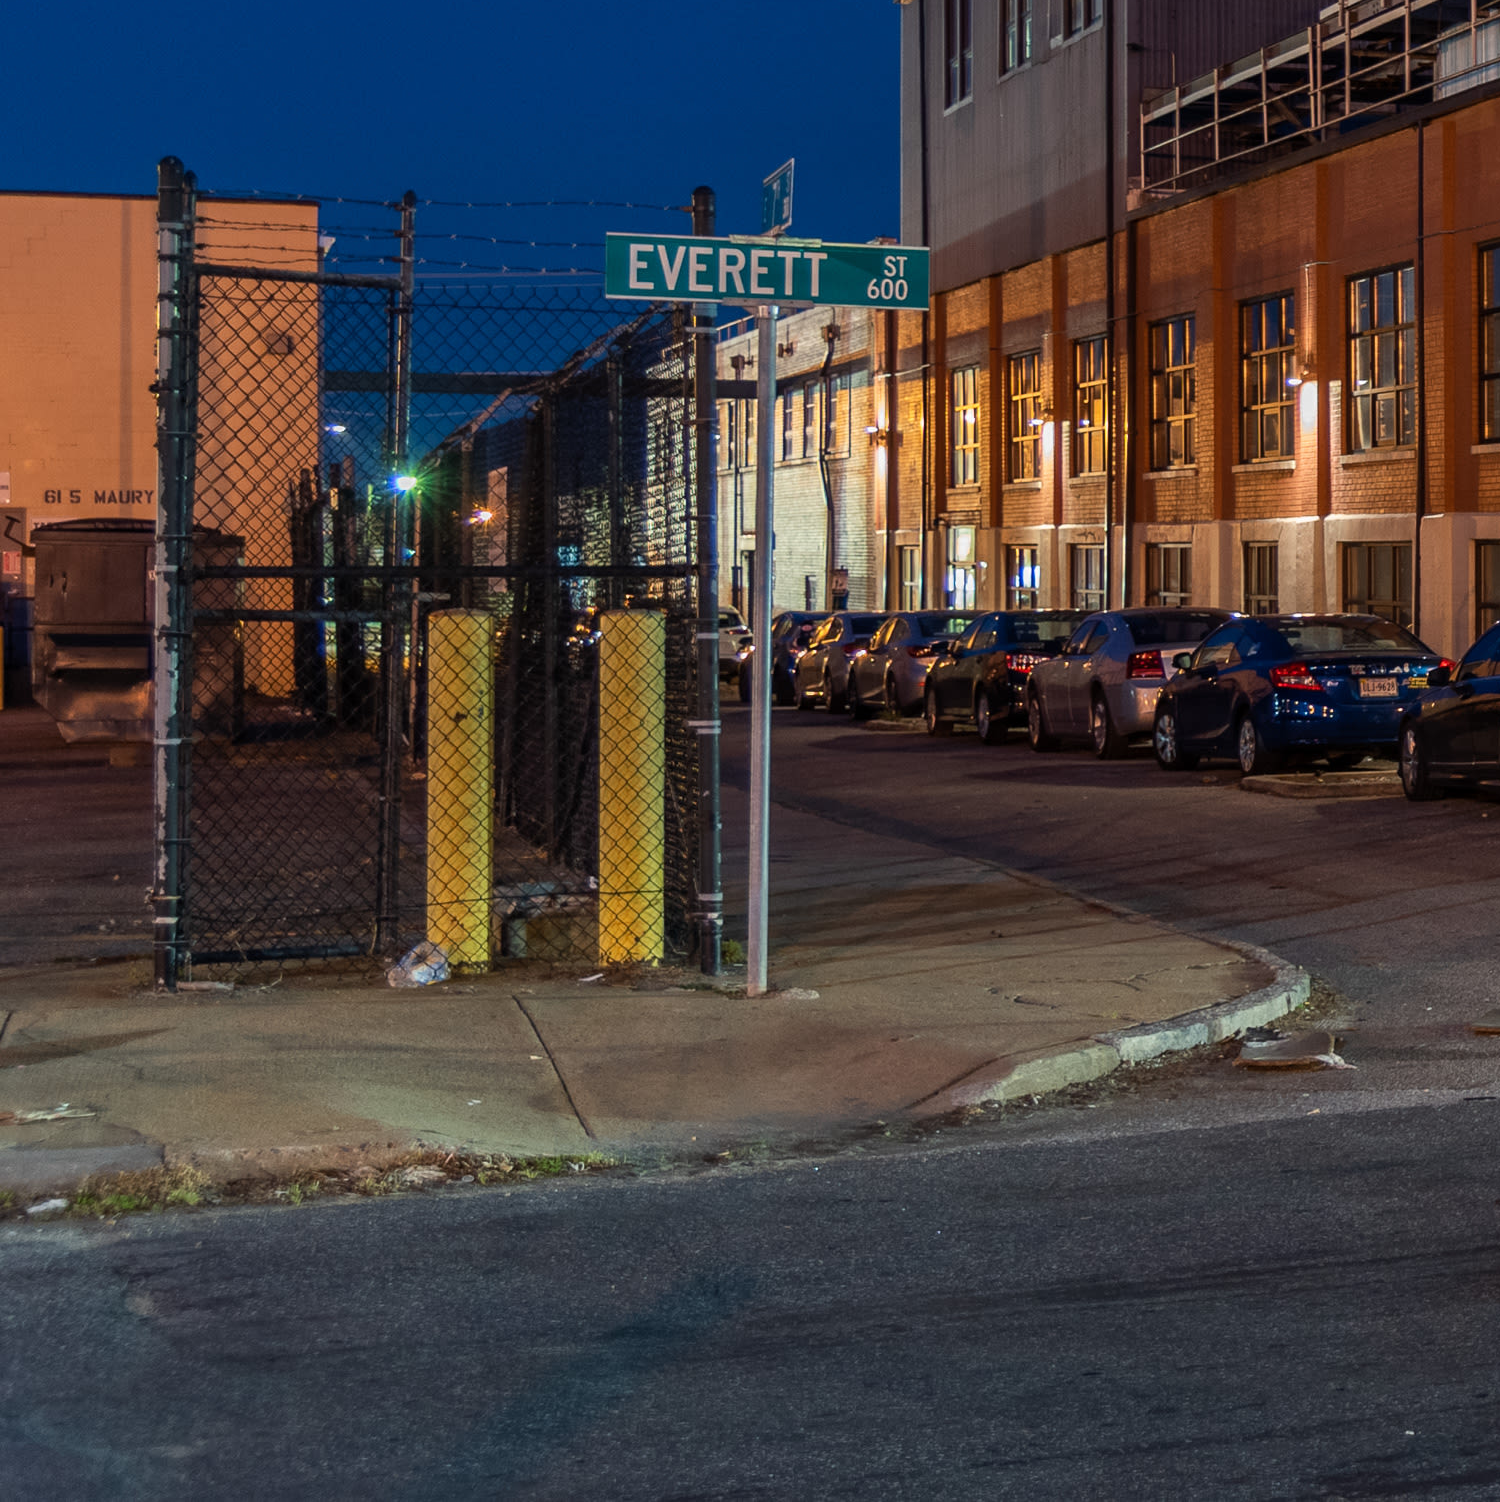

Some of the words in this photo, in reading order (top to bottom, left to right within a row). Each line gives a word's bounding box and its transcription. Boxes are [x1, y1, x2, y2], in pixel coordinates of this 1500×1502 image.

[629, 243, 828, 297] EVERETT
[883, 256, 908, 278] ST
[867, 278, 908, 300] 600
[94, 489, 154, 504] MAURY
